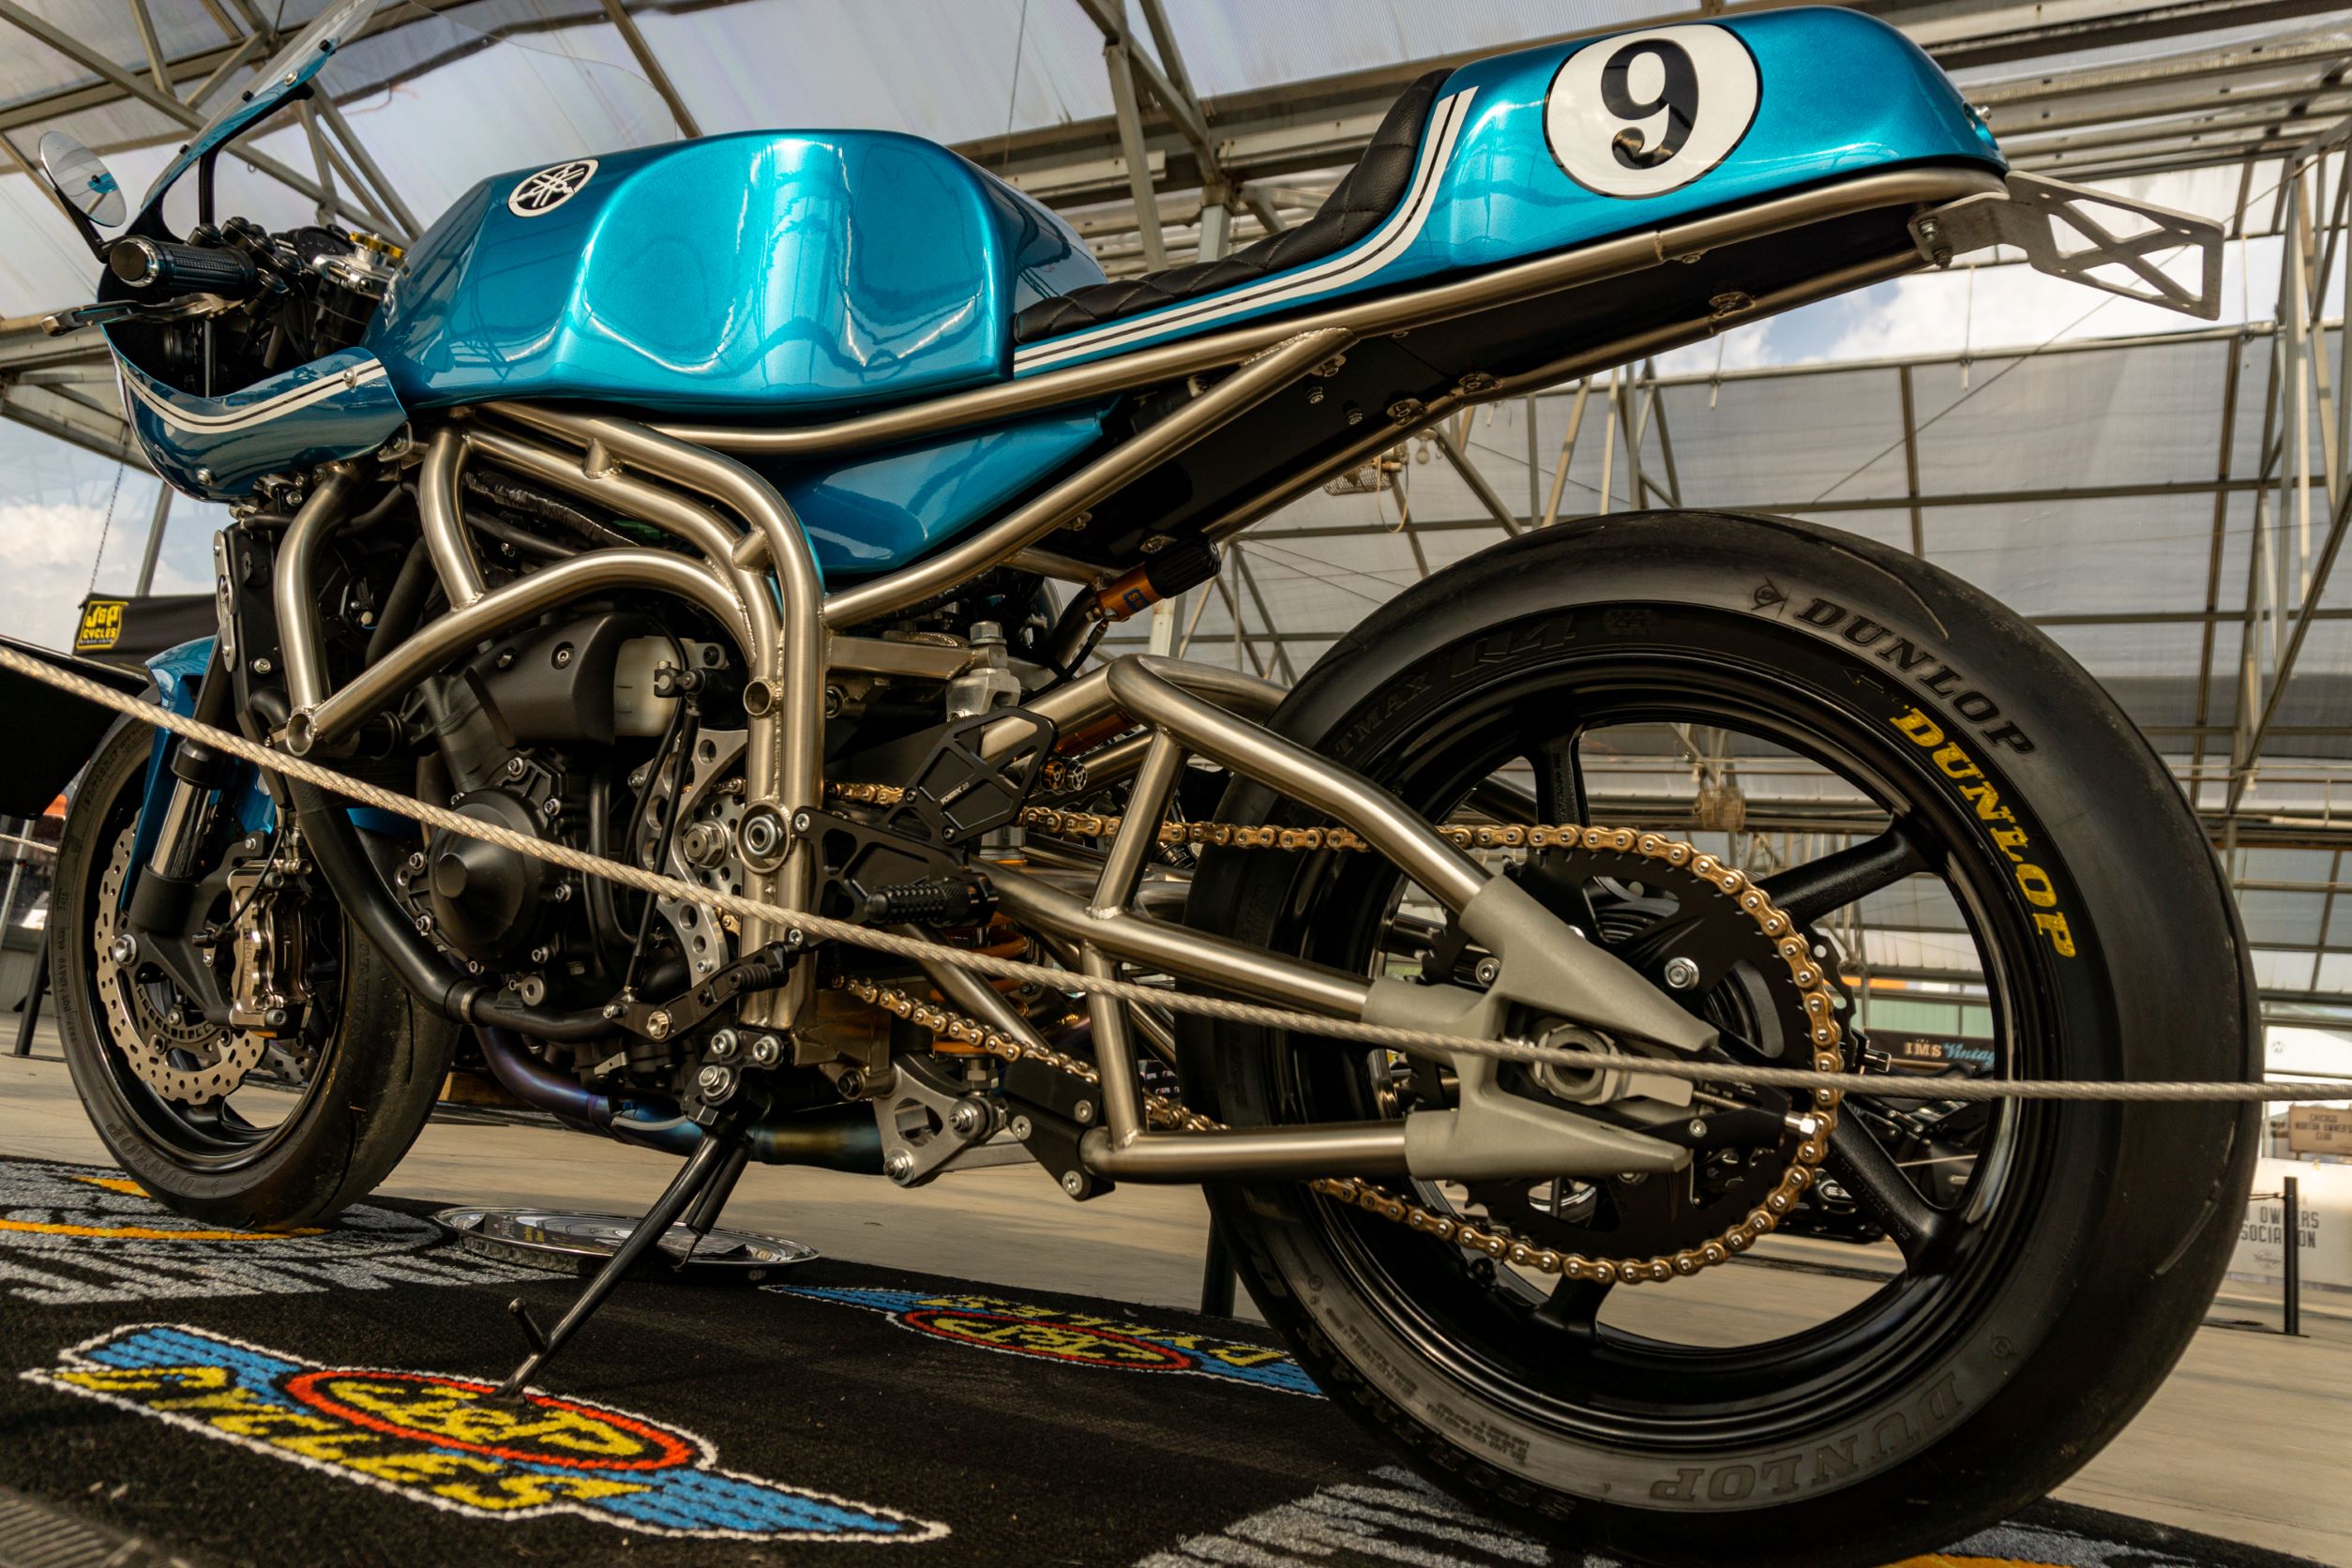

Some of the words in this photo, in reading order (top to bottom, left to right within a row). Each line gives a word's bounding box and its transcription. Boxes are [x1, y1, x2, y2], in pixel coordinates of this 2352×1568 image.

[1600, 38, 1698, 171] 9
[83, 627, 116, 640] CYCLES
[85, 605, 119, 627] J&P
[1795, 597, 2038, 754] DUNLOP
[1889, 707, 2076, 957] DUNLOP
[1905, 1042, 1942, 1058] IMS
[1944, 1042, 1995, 1065] Vintag
[2240, 1223, 2316, 1248] SOCIAON
[2260, 1206, 2320, 1229] OWRS
[53, 1366, 652, 1510] CYCLES
[1649, 1371, 1965, 1500] DUNLOP
